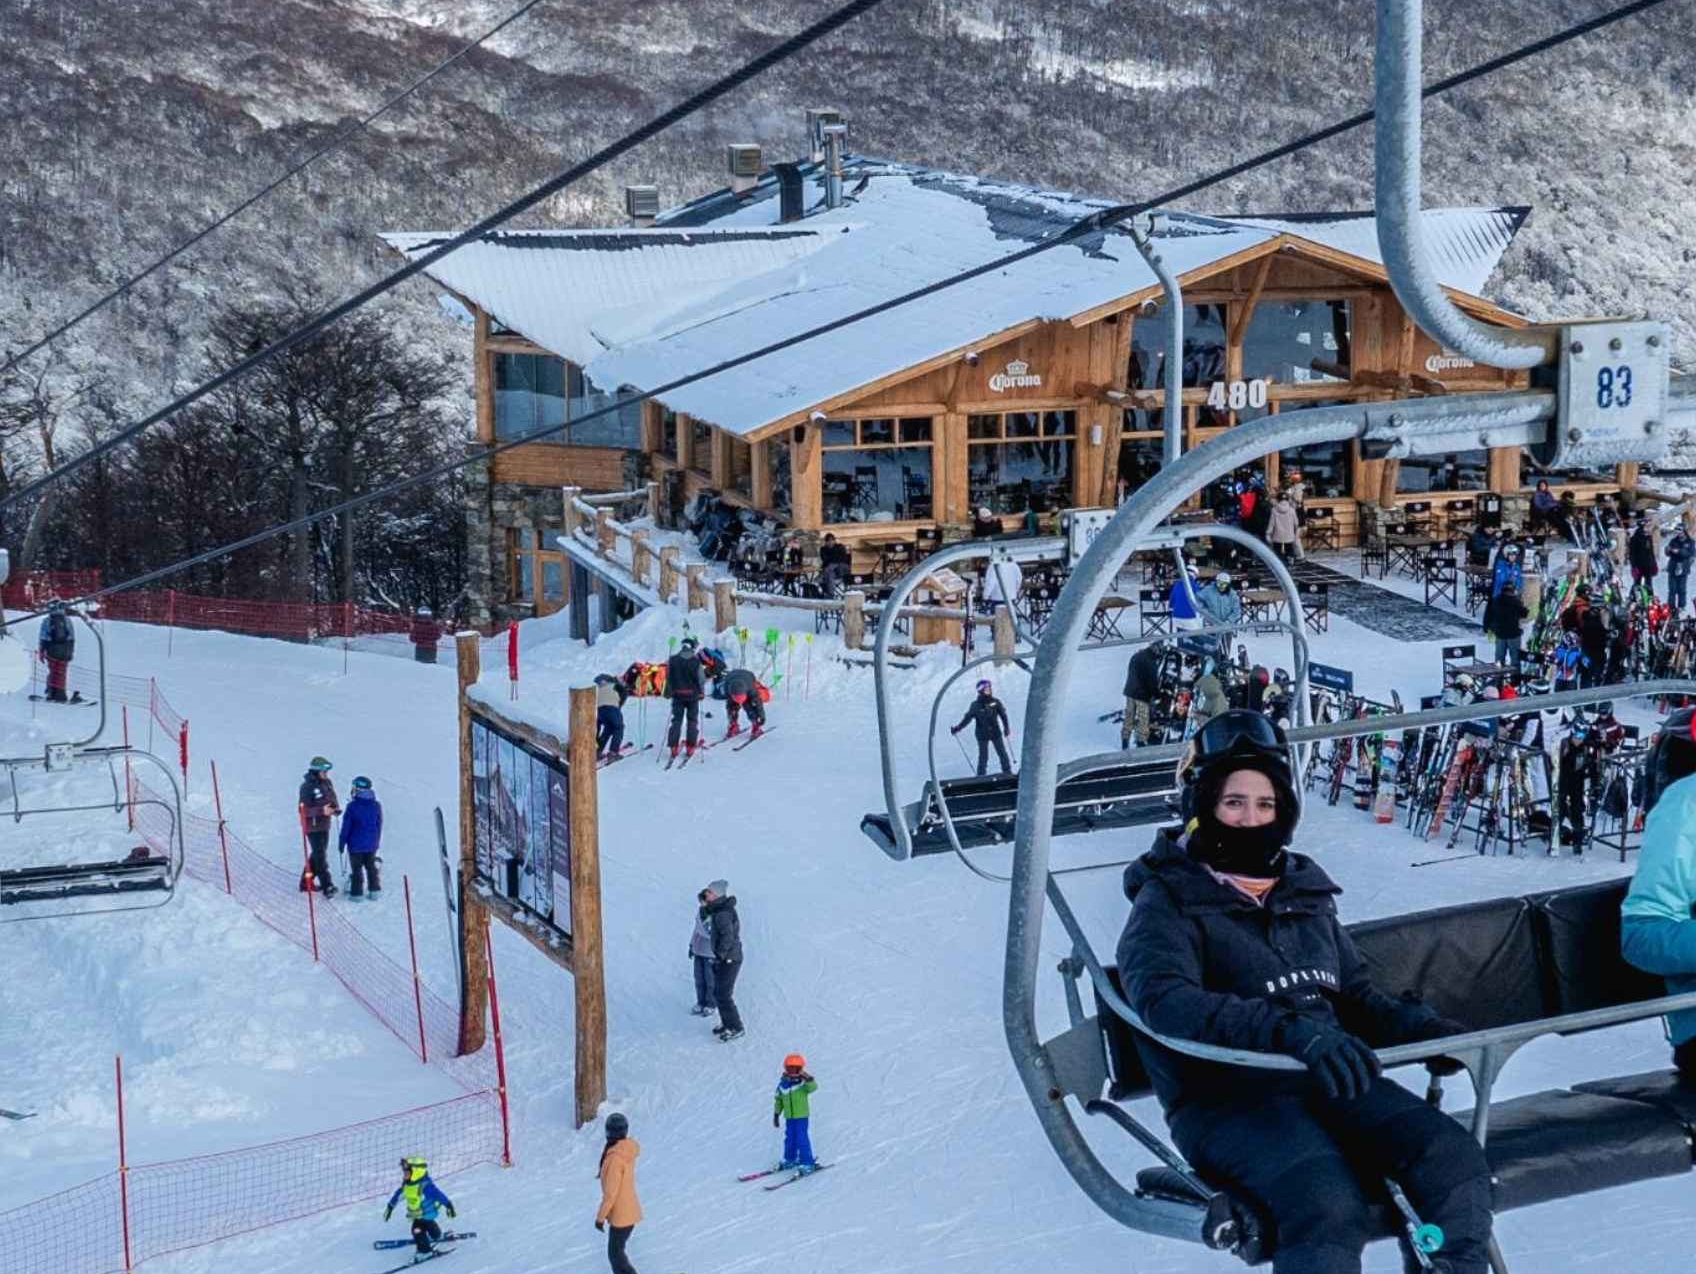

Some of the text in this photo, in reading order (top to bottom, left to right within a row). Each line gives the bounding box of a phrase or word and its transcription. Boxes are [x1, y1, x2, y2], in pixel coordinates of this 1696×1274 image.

[989, 372, 1041, 393] Corona
[1207, 379, 1267, 411] 480
[1597, 365, 1632, 408] 83
